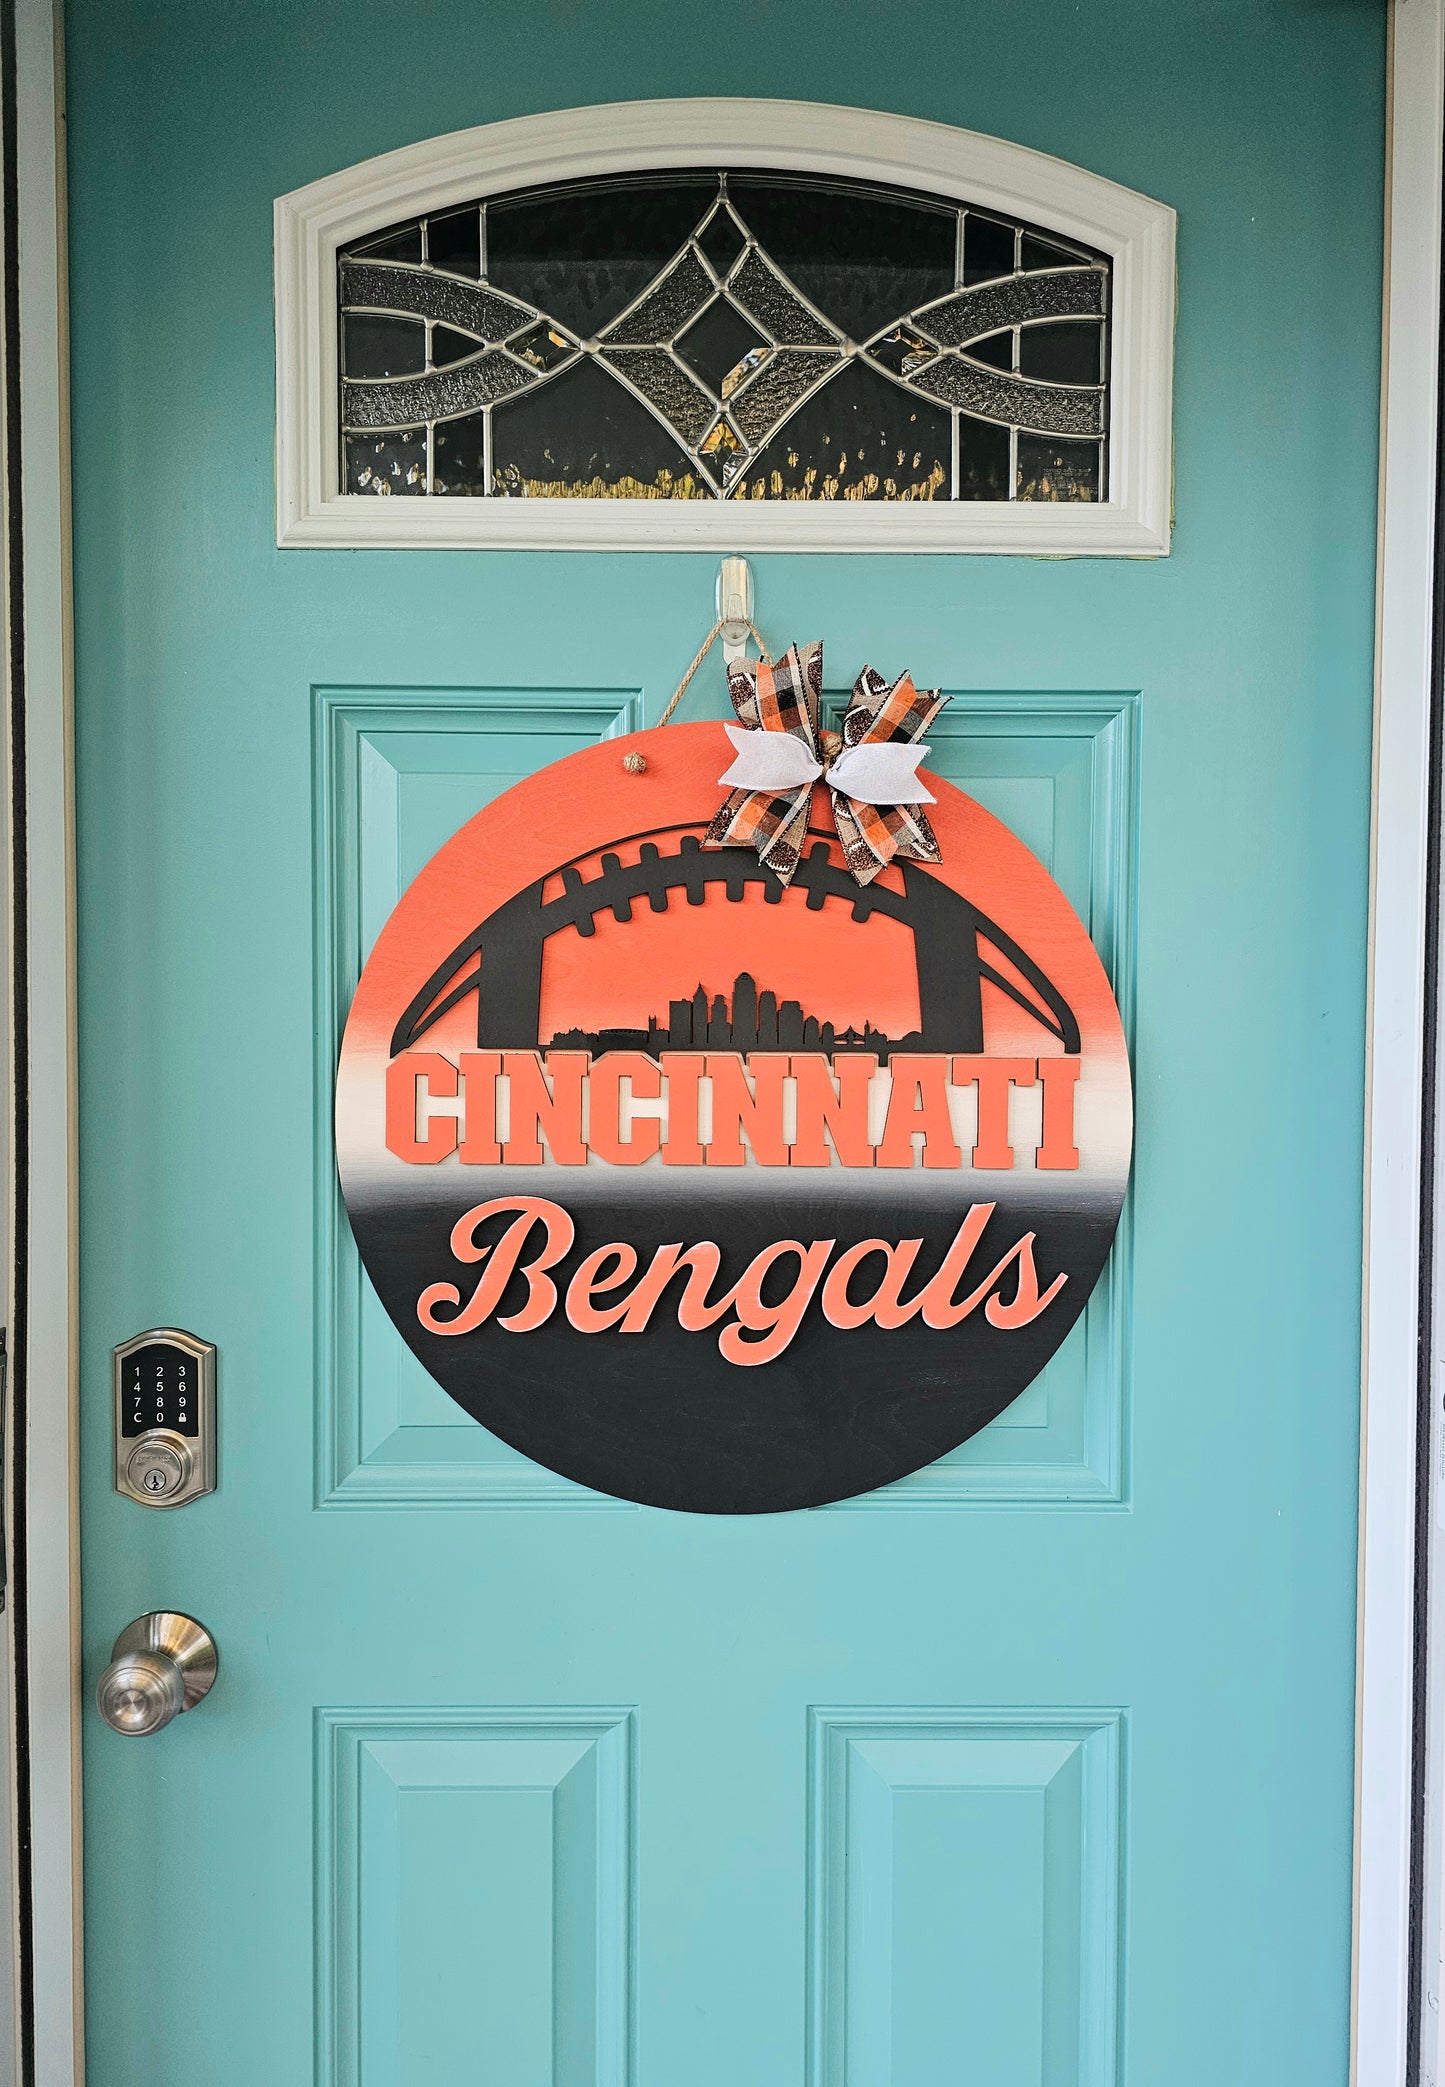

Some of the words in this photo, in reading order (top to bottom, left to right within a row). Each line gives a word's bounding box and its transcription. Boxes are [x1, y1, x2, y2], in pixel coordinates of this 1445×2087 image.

[385, 1051, 1082, 1170] CINCINNATI
[416, 1195, 1068, 1367] Bengals
[134, 1366, 140, 1377] 1
[156, 1366, 164, 1377] 2
[178, 1366, 185, 1377] 3
[133, 1381, 141, 1392] 4
[156, 1381, 164, 1392] 5
[178, 1381, 186, 1392] 6
[133, 1396, 141, 1407] 7
[156, 1396, 164, 1407] 8
[178, 1396, 186, 1407] 9
[133, 1412, 142, 1423] C
